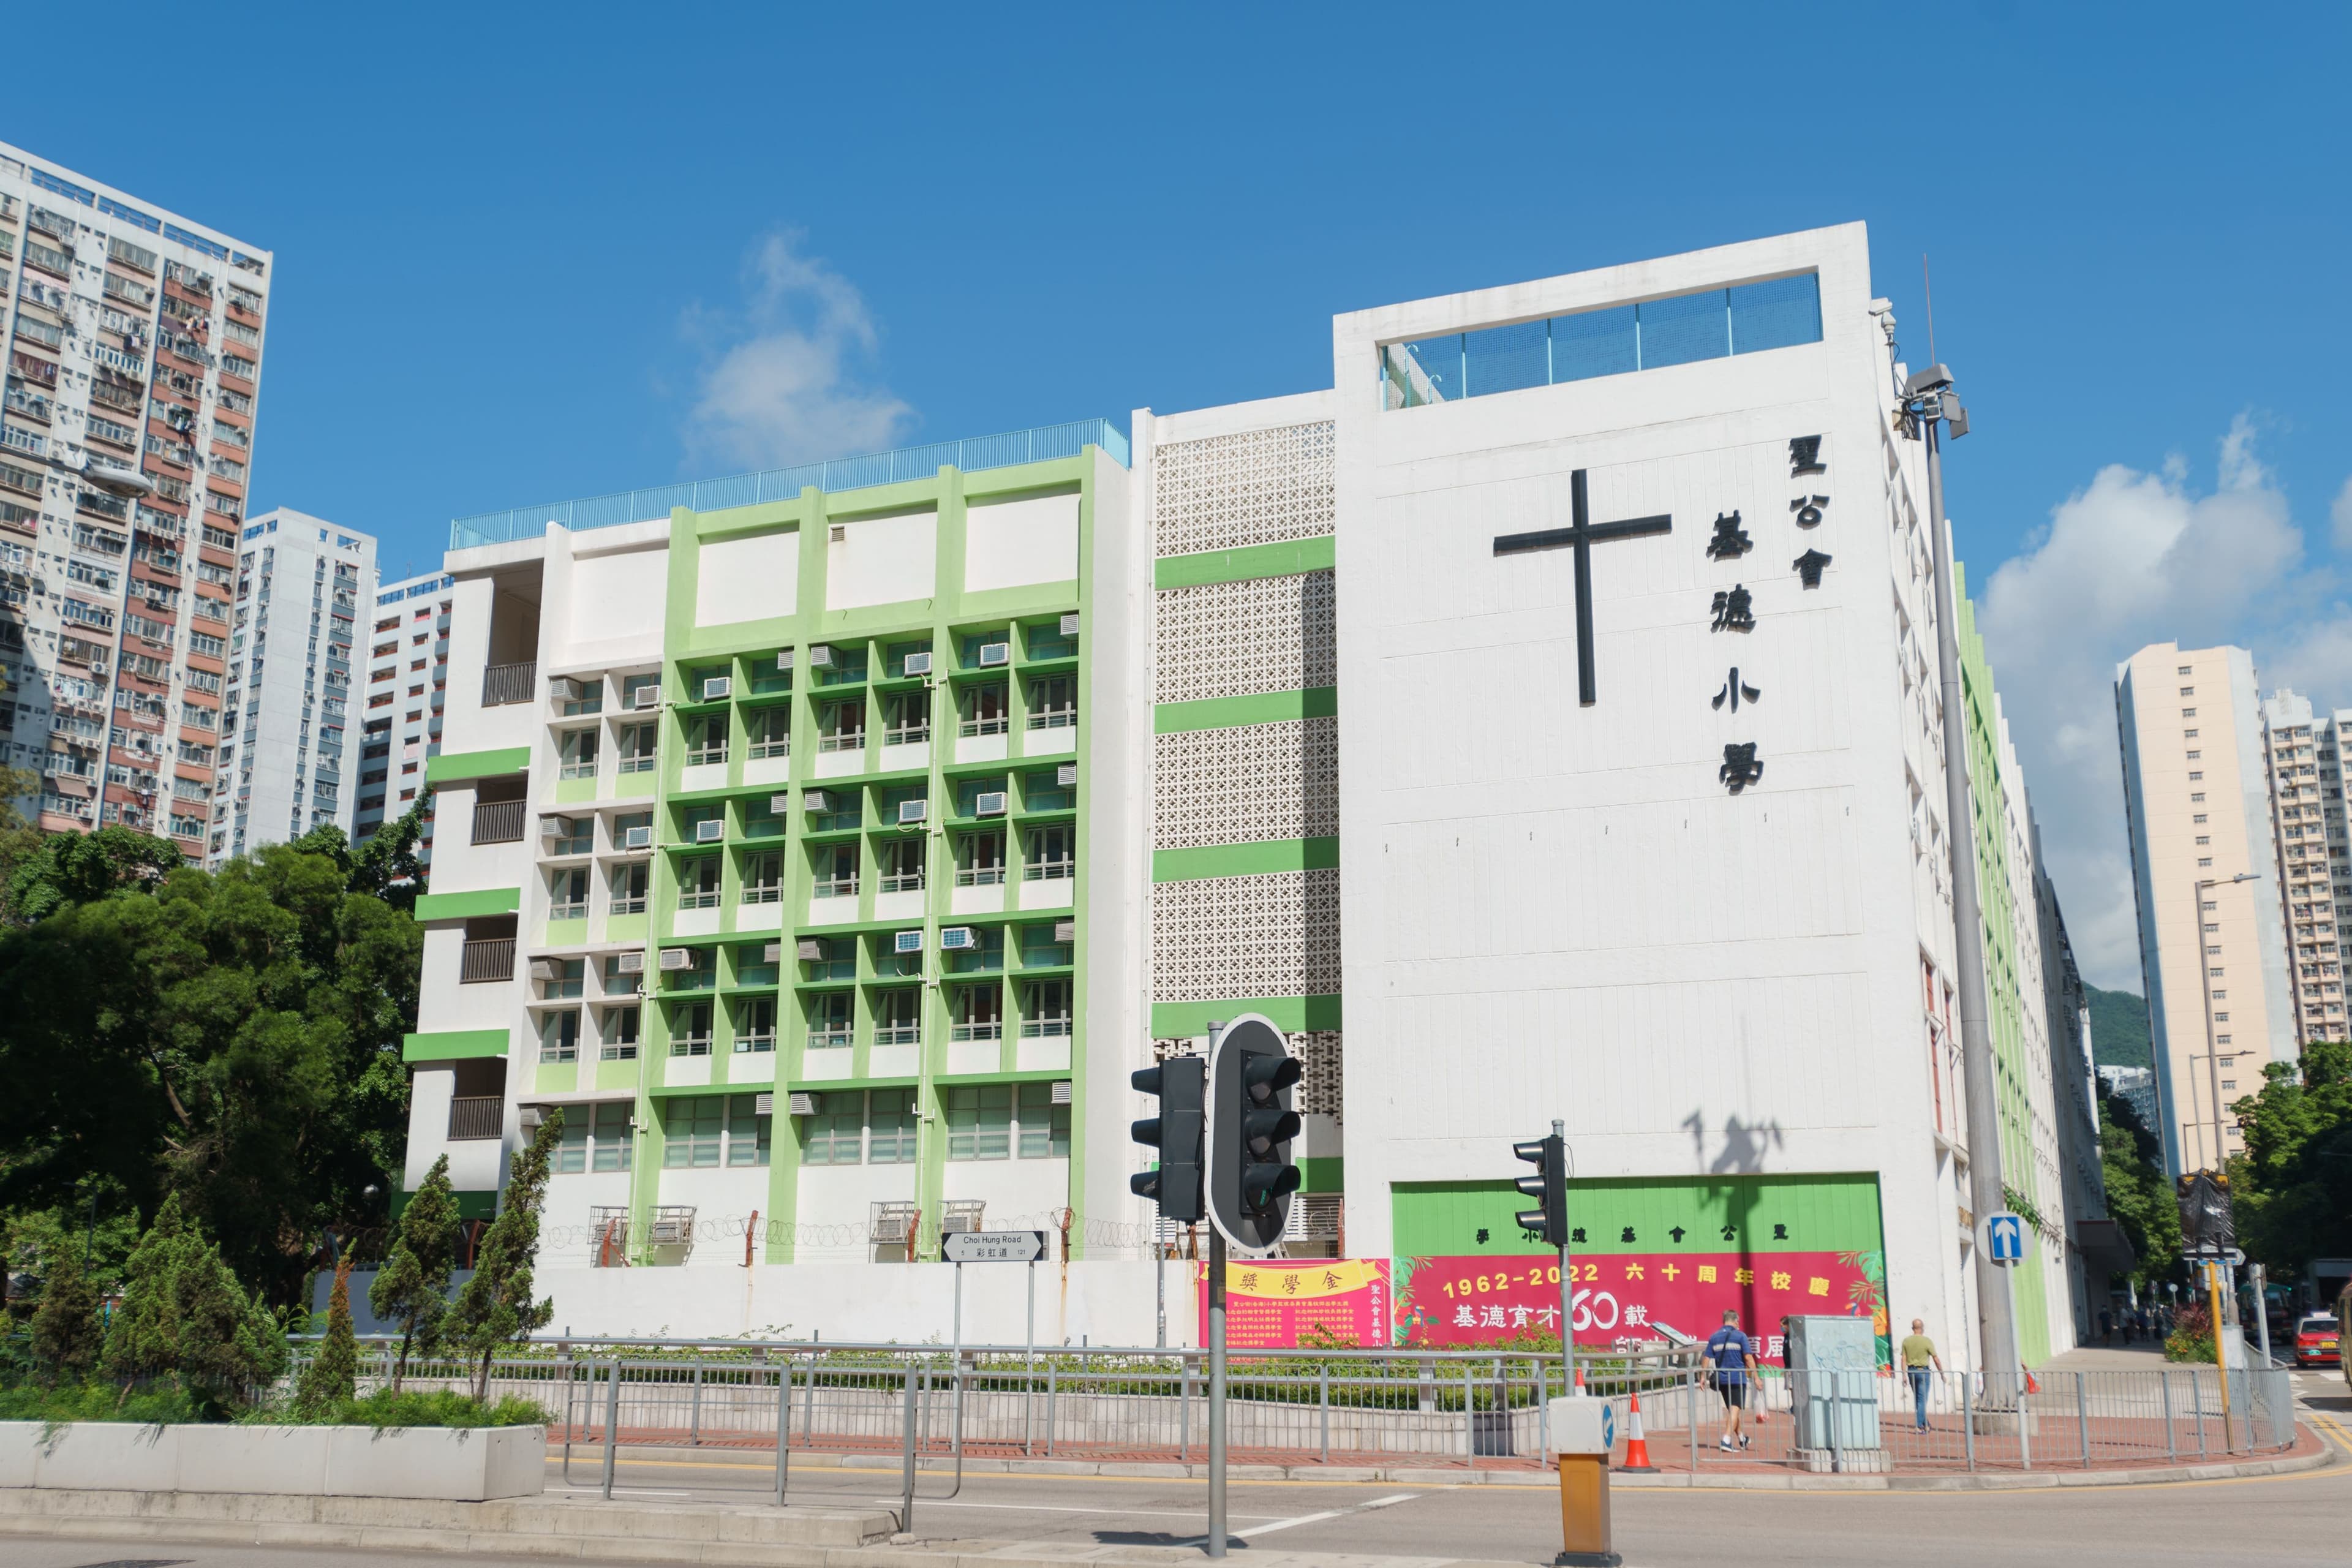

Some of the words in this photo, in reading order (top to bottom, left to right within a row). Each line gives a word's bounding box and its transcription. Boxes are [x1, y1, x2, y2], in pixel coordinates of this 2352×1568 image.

[1789, 434, 1833, 589] 聖公會
[1706, 509, 1764, 794] 基德小學
[976, 1248, 1008, 1257] 彩虹道
[982, 1236, 1000, 1245] Hung
[1239, 1270, 1343, 1295] 獎學金
[1442, 1264, 1599, 1298] 1962-2022
[1625, 1262, 1830, 1297] 六十周年校慶
